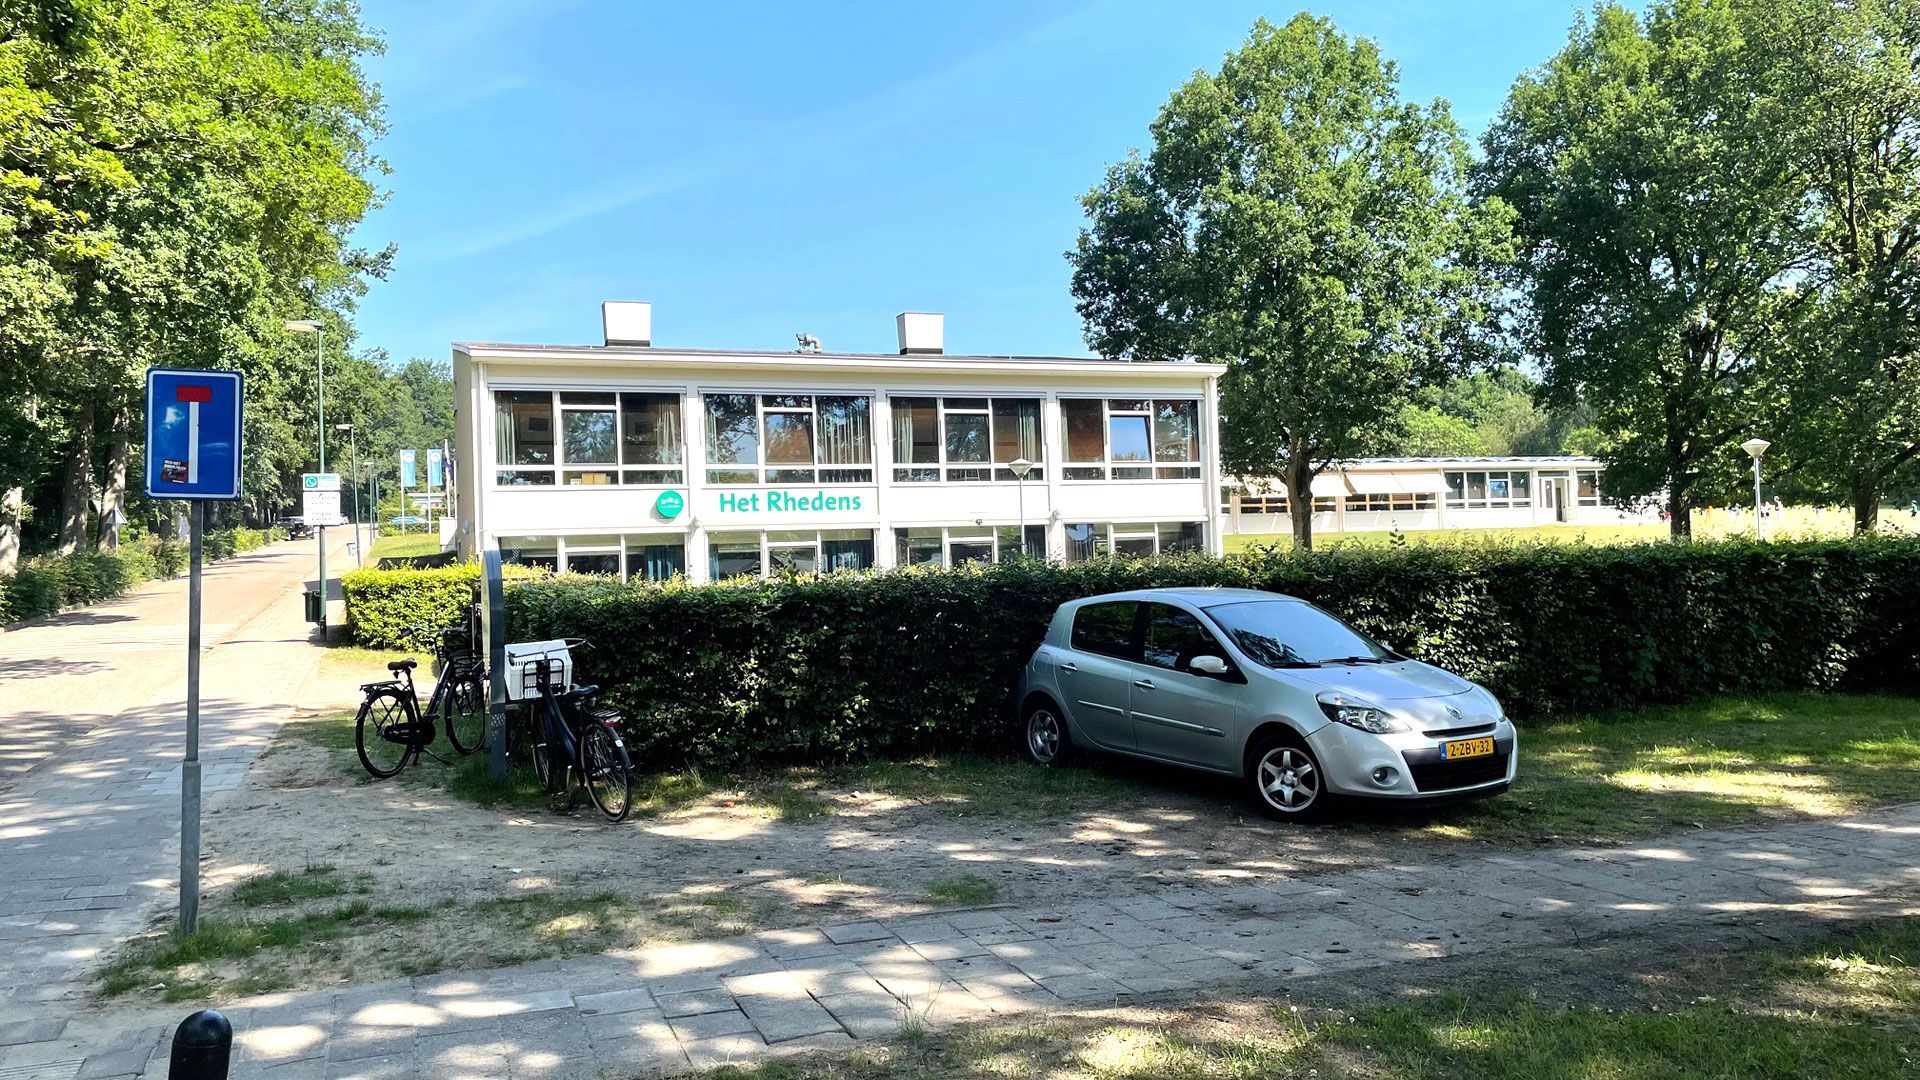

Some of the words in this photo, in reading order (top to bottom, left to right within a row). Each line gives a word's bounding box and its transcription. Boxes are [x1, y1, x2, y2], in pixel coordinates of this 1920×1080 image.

[719, 492, 760, 513] Het
[767, 490, 862, 512] Rhedens
[1450, 740, 1490, 757] 2-ZBV-32
